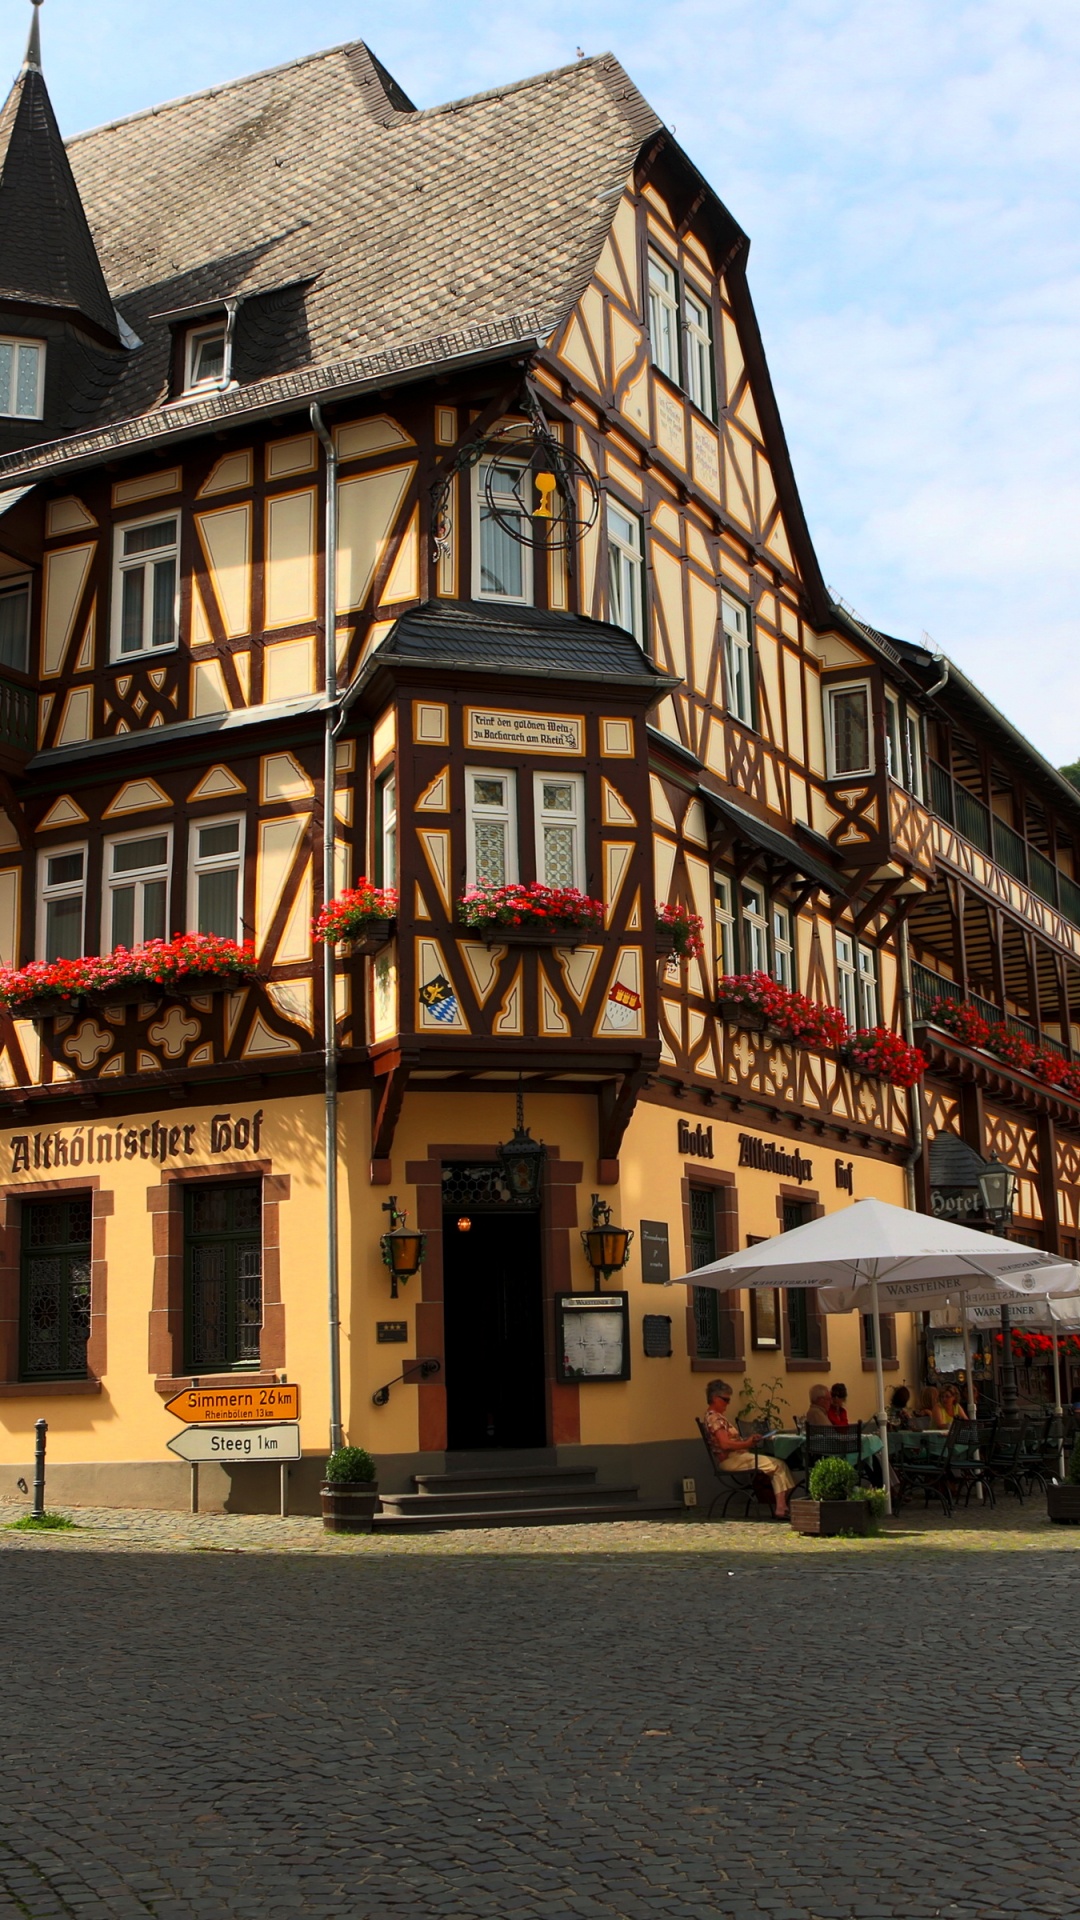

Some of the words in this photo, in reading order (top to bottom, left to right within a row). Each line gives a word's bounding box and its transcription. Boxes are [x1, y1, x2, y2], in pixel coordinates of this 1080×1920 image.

[474, 714, 495, 727] Trink
[497, 716, 511, 728] den
[514, 718, 546, 731] goldnen
[474, 731, 483, 740] zu
[484, 729, 525, 743] Bacharach
[526, 734, 539, 743] am
[541, 734, 565, 746] Rhein
[10, 1119, 196, 1173] Altkölnischer
[211, 1109, 263, 1154] Hof
[677, 1118, 715, 1160] Hotel
[738, 1132, 813, 1185] Altkölnischer
[835, 1158, 853, 1196] Hof
[930, 1190, 980, 1216] Hotel
[886, 1278, 961, 1296] WARSTEINER
[973, 1306, 1035, 1317] WARSEINER
[188, 1392, 253, 1408] Simmern
[259, 1389, 276, 1405] 26
[278, 1392, 292, 1405] km
[256, 1408, 265, 1417] 13
[211, 1436, 251, 1454] Steeg
[258, 1434, 262, 1450] 1
[264, 1437, 278, 1450] km
